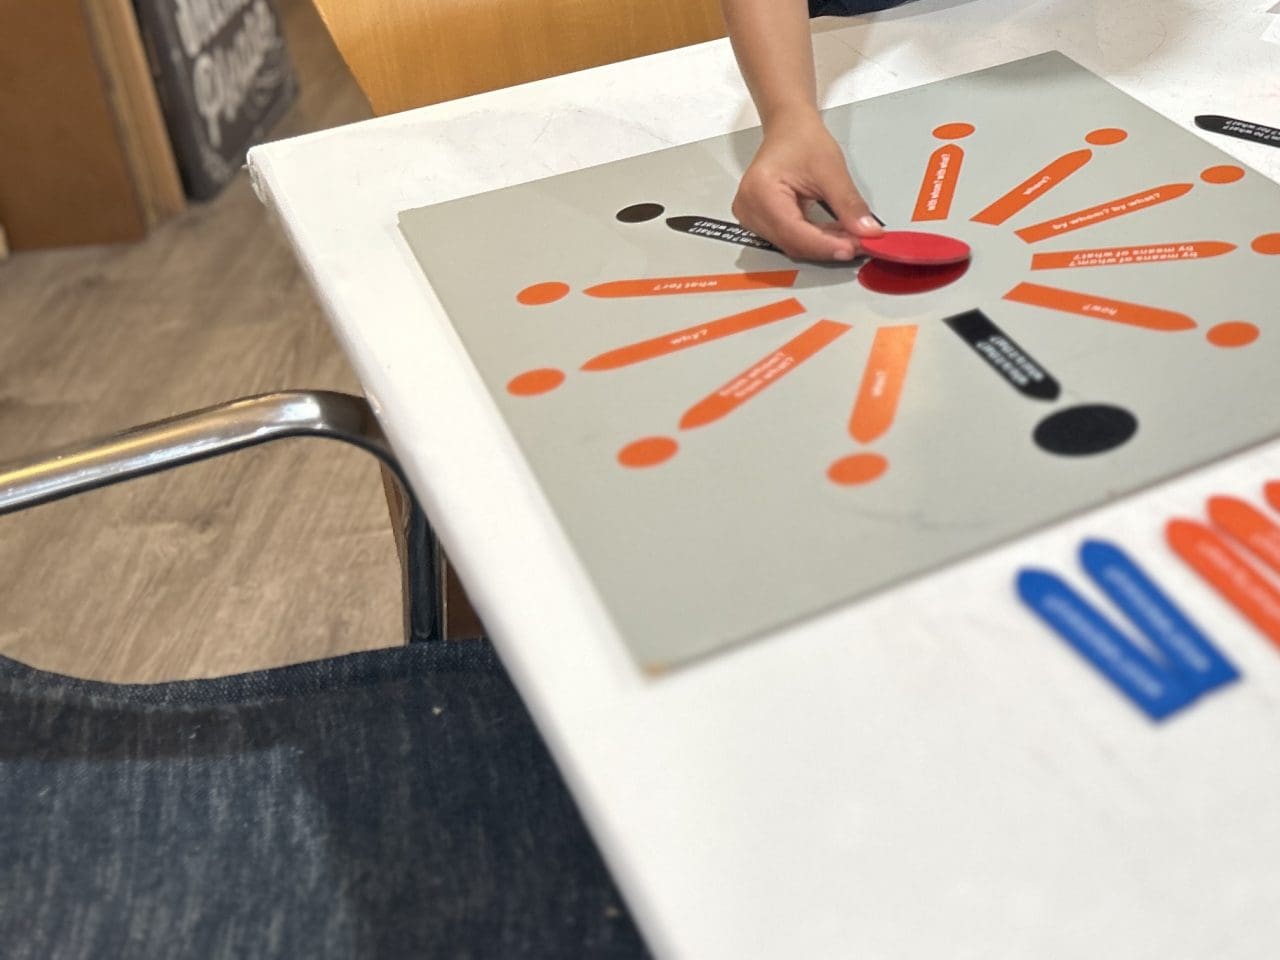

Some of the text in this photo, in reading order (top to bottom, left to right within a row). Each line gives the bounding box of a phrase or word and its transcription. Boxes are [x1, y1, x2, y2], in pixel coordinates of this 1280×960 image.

[1222, 124, 1254, 135] what?
[1225, 120, 1257, 130] what?
[1052, 221, 1069, 231] by
[1069, 207, 1110, 226] whom?
[1127, 191, 1161, 208] what?
[693, 220, 728, 231] what?
[688, 227, 722, 238] what?
[1072, 251, 1114, 261] what?
[1132, 247, 1176, 256] means
[1068, 257, 1117, 268] whom?
[652, 280, 719, 292] what for?
[1081, 304, 1118, 316] how?
[671, 328, 709, 345] why?
